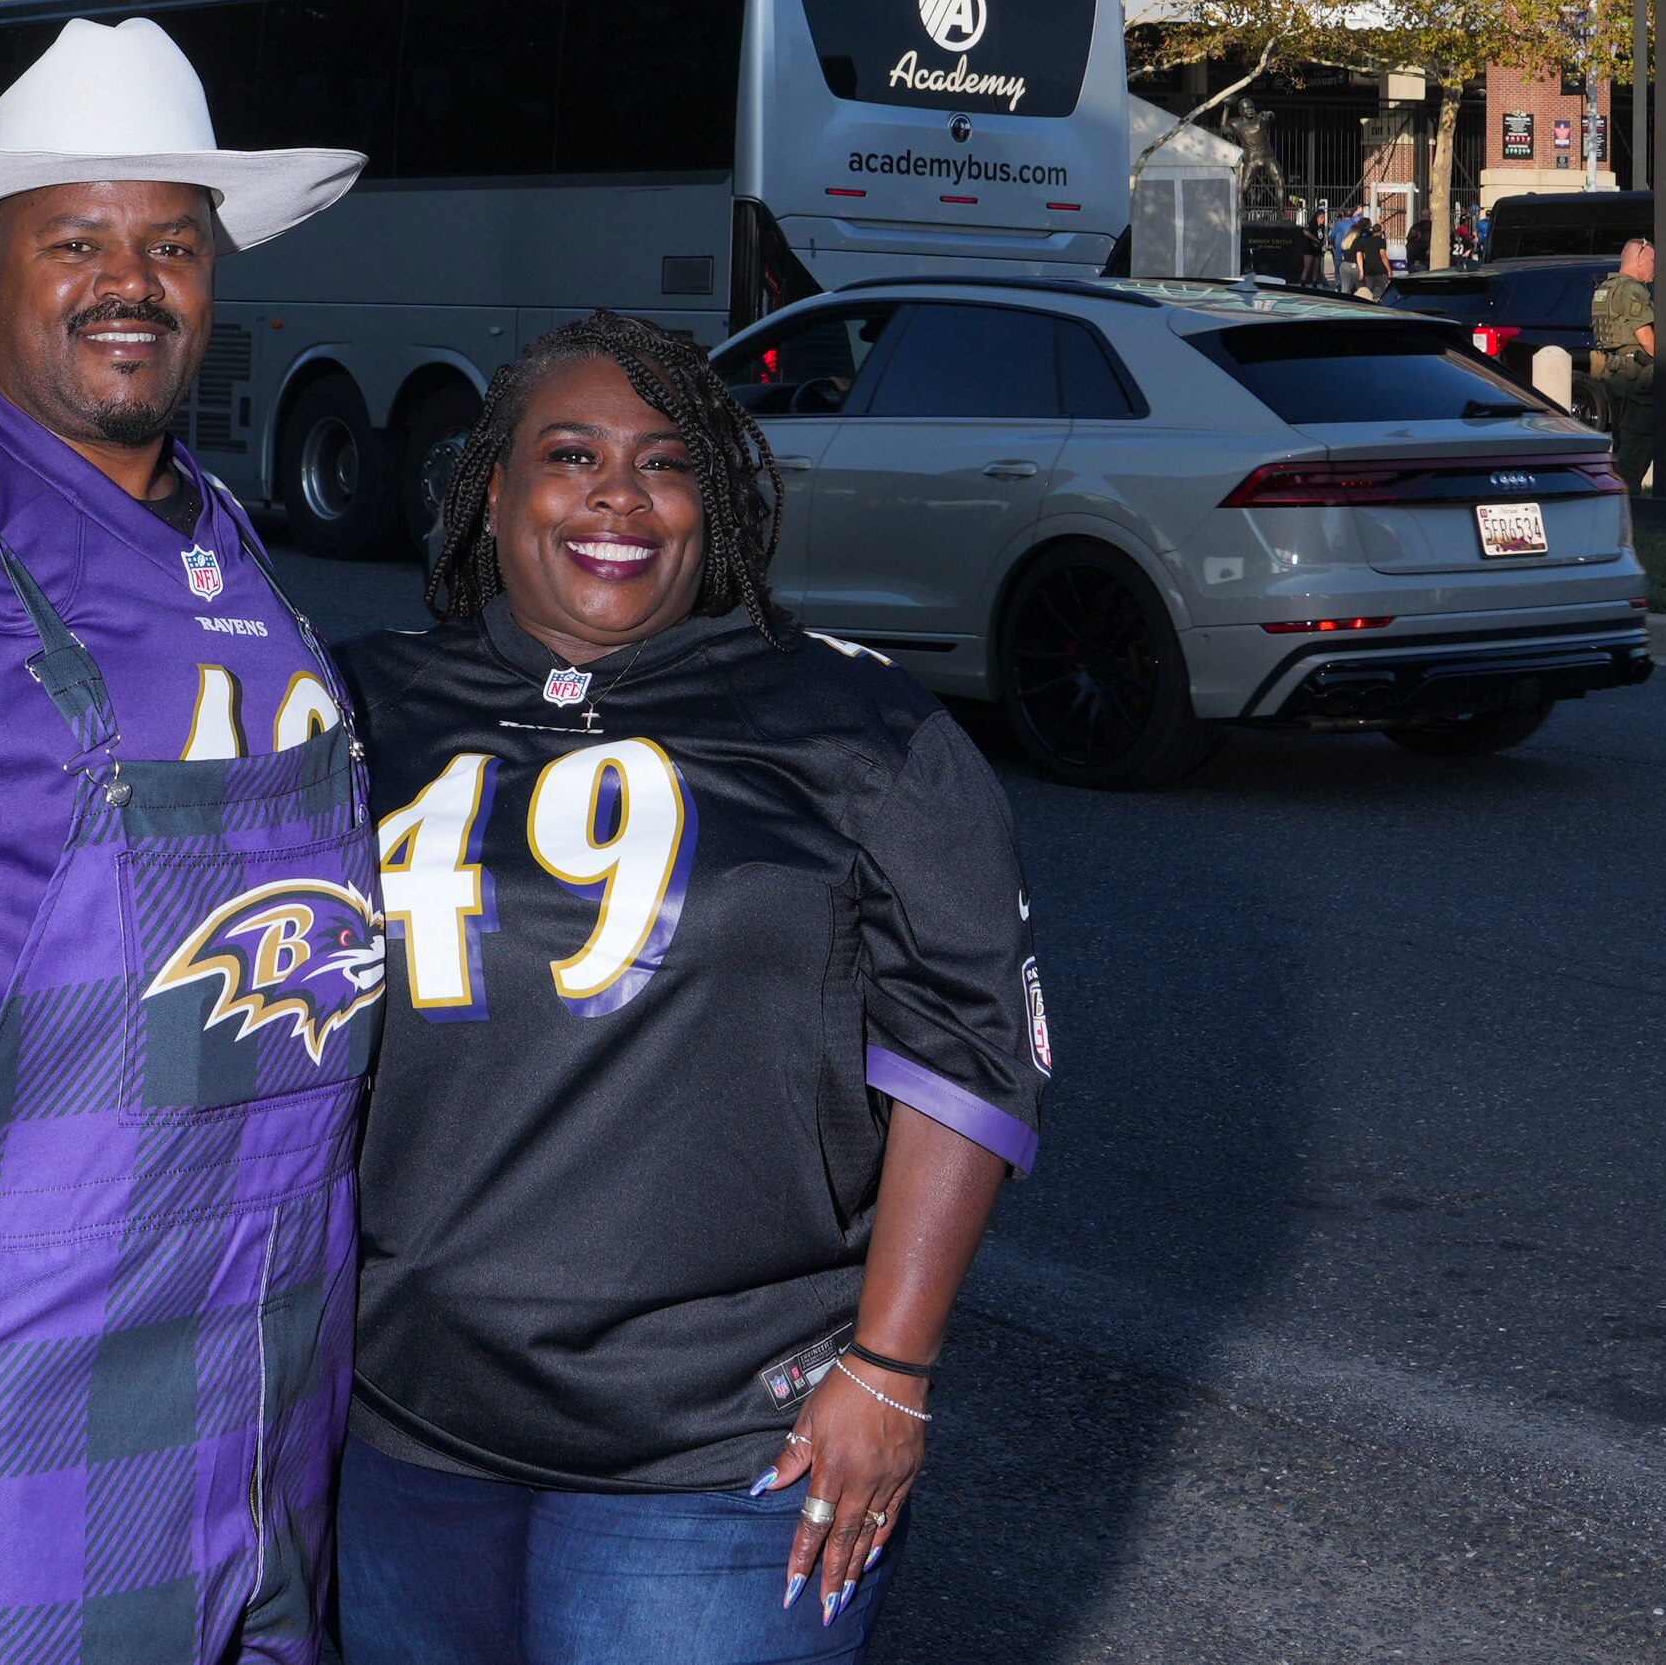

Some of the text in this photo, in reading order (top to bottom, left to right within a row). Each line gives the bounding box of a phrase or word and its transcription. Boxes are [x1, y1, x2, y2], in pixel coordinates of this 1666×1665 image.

[888, 50, 1026, 112] Academy
[848, 149, 1069, 187] academybus.com
[1483, 516, 1542, 542] 5FR6534
[195, 569, 219, 591] NFL
[194, 615, 269, 638] RAVENS
[549, 682, 579, 698] NFL
[378, 737, 689, 1015] 49
